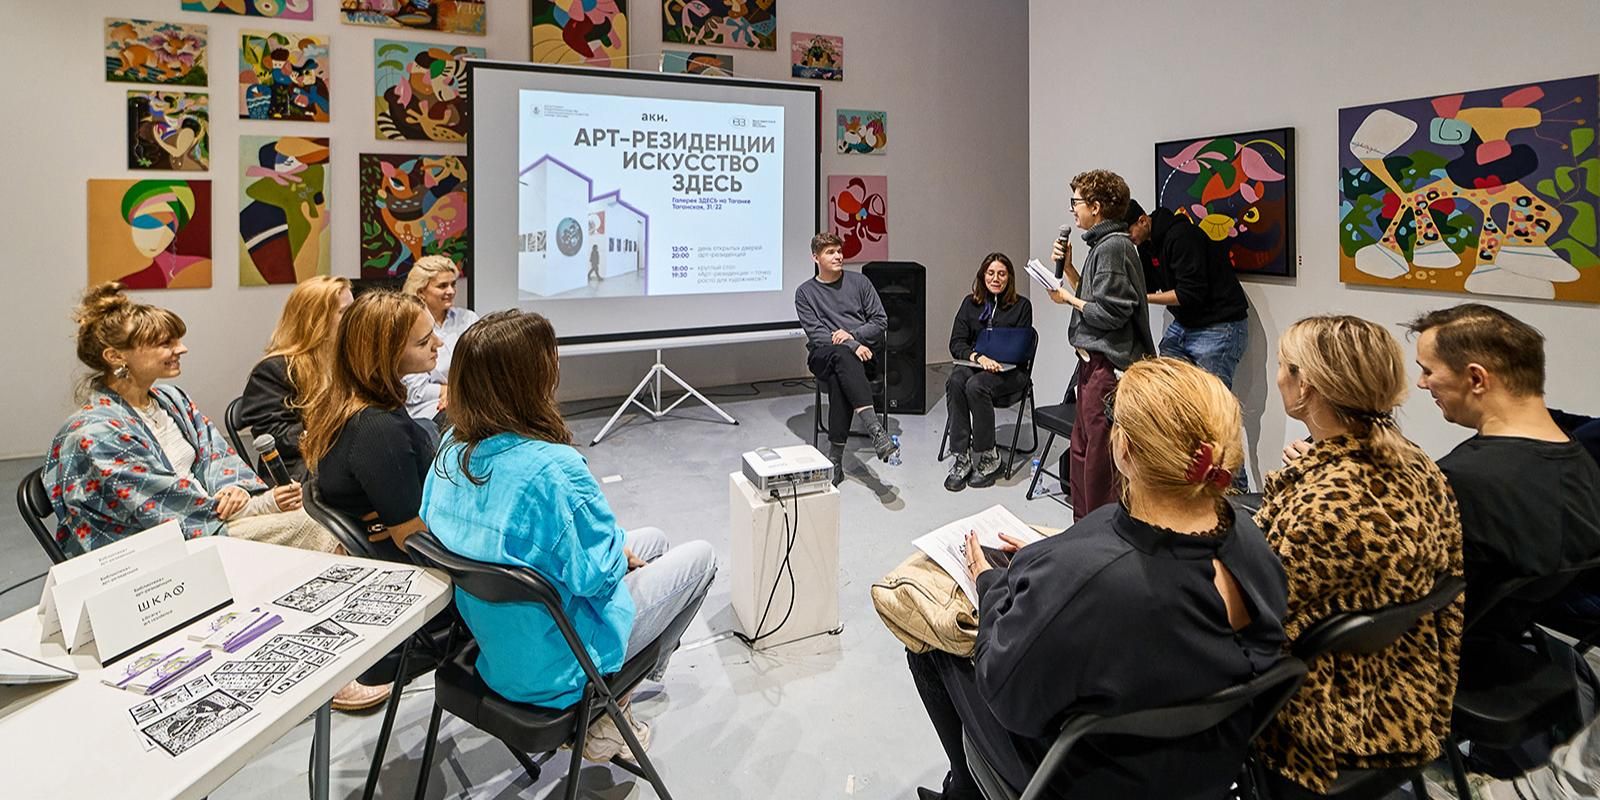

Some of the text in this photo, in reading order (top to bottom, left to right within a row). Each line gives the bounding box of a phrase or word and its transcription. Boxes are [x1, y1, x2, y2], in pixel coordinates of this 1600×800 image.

[641, 112, 668, 122] аки.
[574, 128, 775, 155] АРТ-РЕЗИДЕНЦИИ
[623, 151, 759, 173] ИСКУССТВО
[672, 174, 743, 195] ЗДЕСЬ
